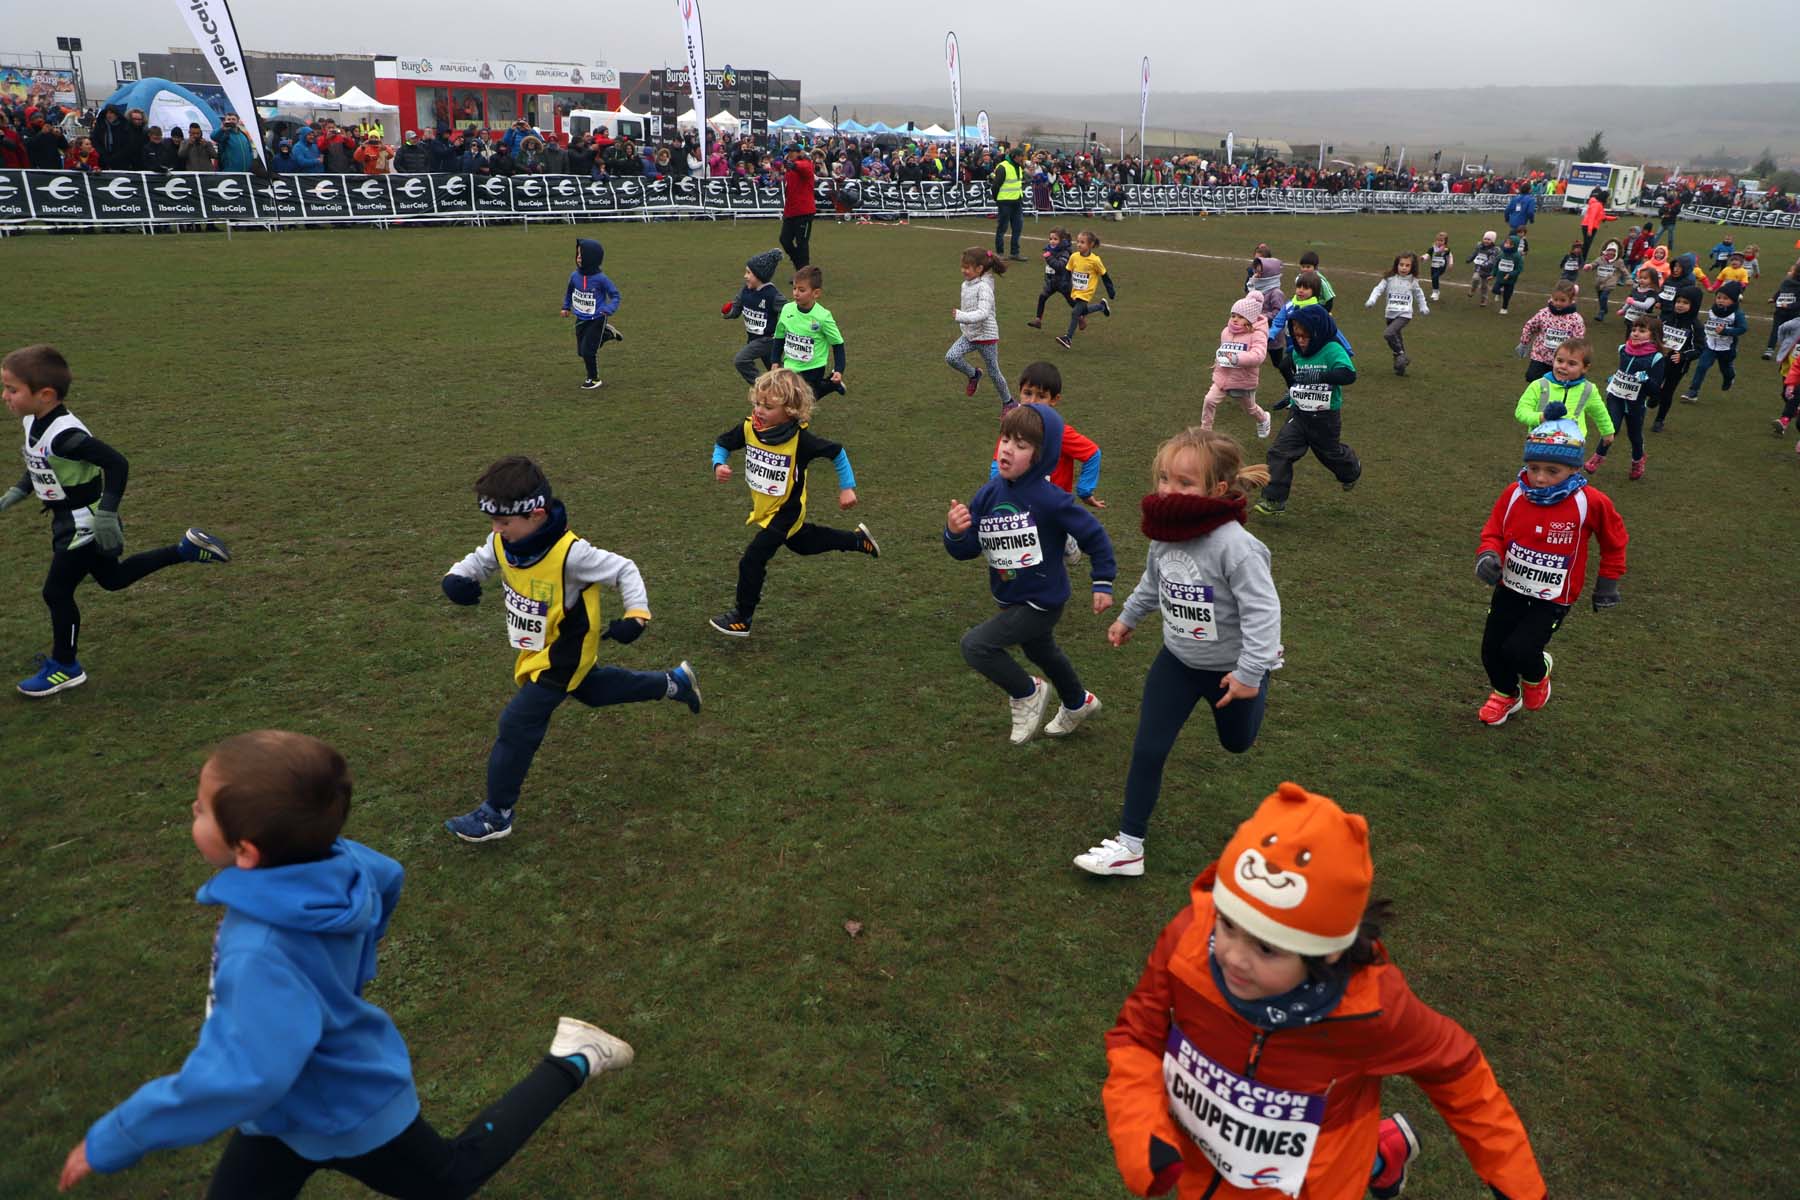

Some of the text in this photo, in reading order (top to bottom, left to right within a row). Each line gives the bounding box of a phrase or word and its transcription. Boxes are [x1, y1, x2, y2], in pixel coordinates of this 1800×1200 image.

[356, 203, 387, 211] iberCaja
[441, 199, 467, 207] iberCaja
[42, 205, 83, 214] iberCaja
[102, 204, 141, 213] iberCaja
[158, 204, 195, 213] iberCaja
[211, 204, 247, 213] iberCaja
[310, 204, 342, 212] iberCaja
[1511, 542, 1565, 562] DIPUTACIÓN
[1510, 548, 1563, 570] BURGOS
[1506, 557, 1563, 587] CHUPETINES
[1179, 1039, 1309, 1107] DIPUTACIÓN
[1177, 1052, 1306, 1121] BURGOS
[1171, 1073, 1307, 1157] CHUPETINES
